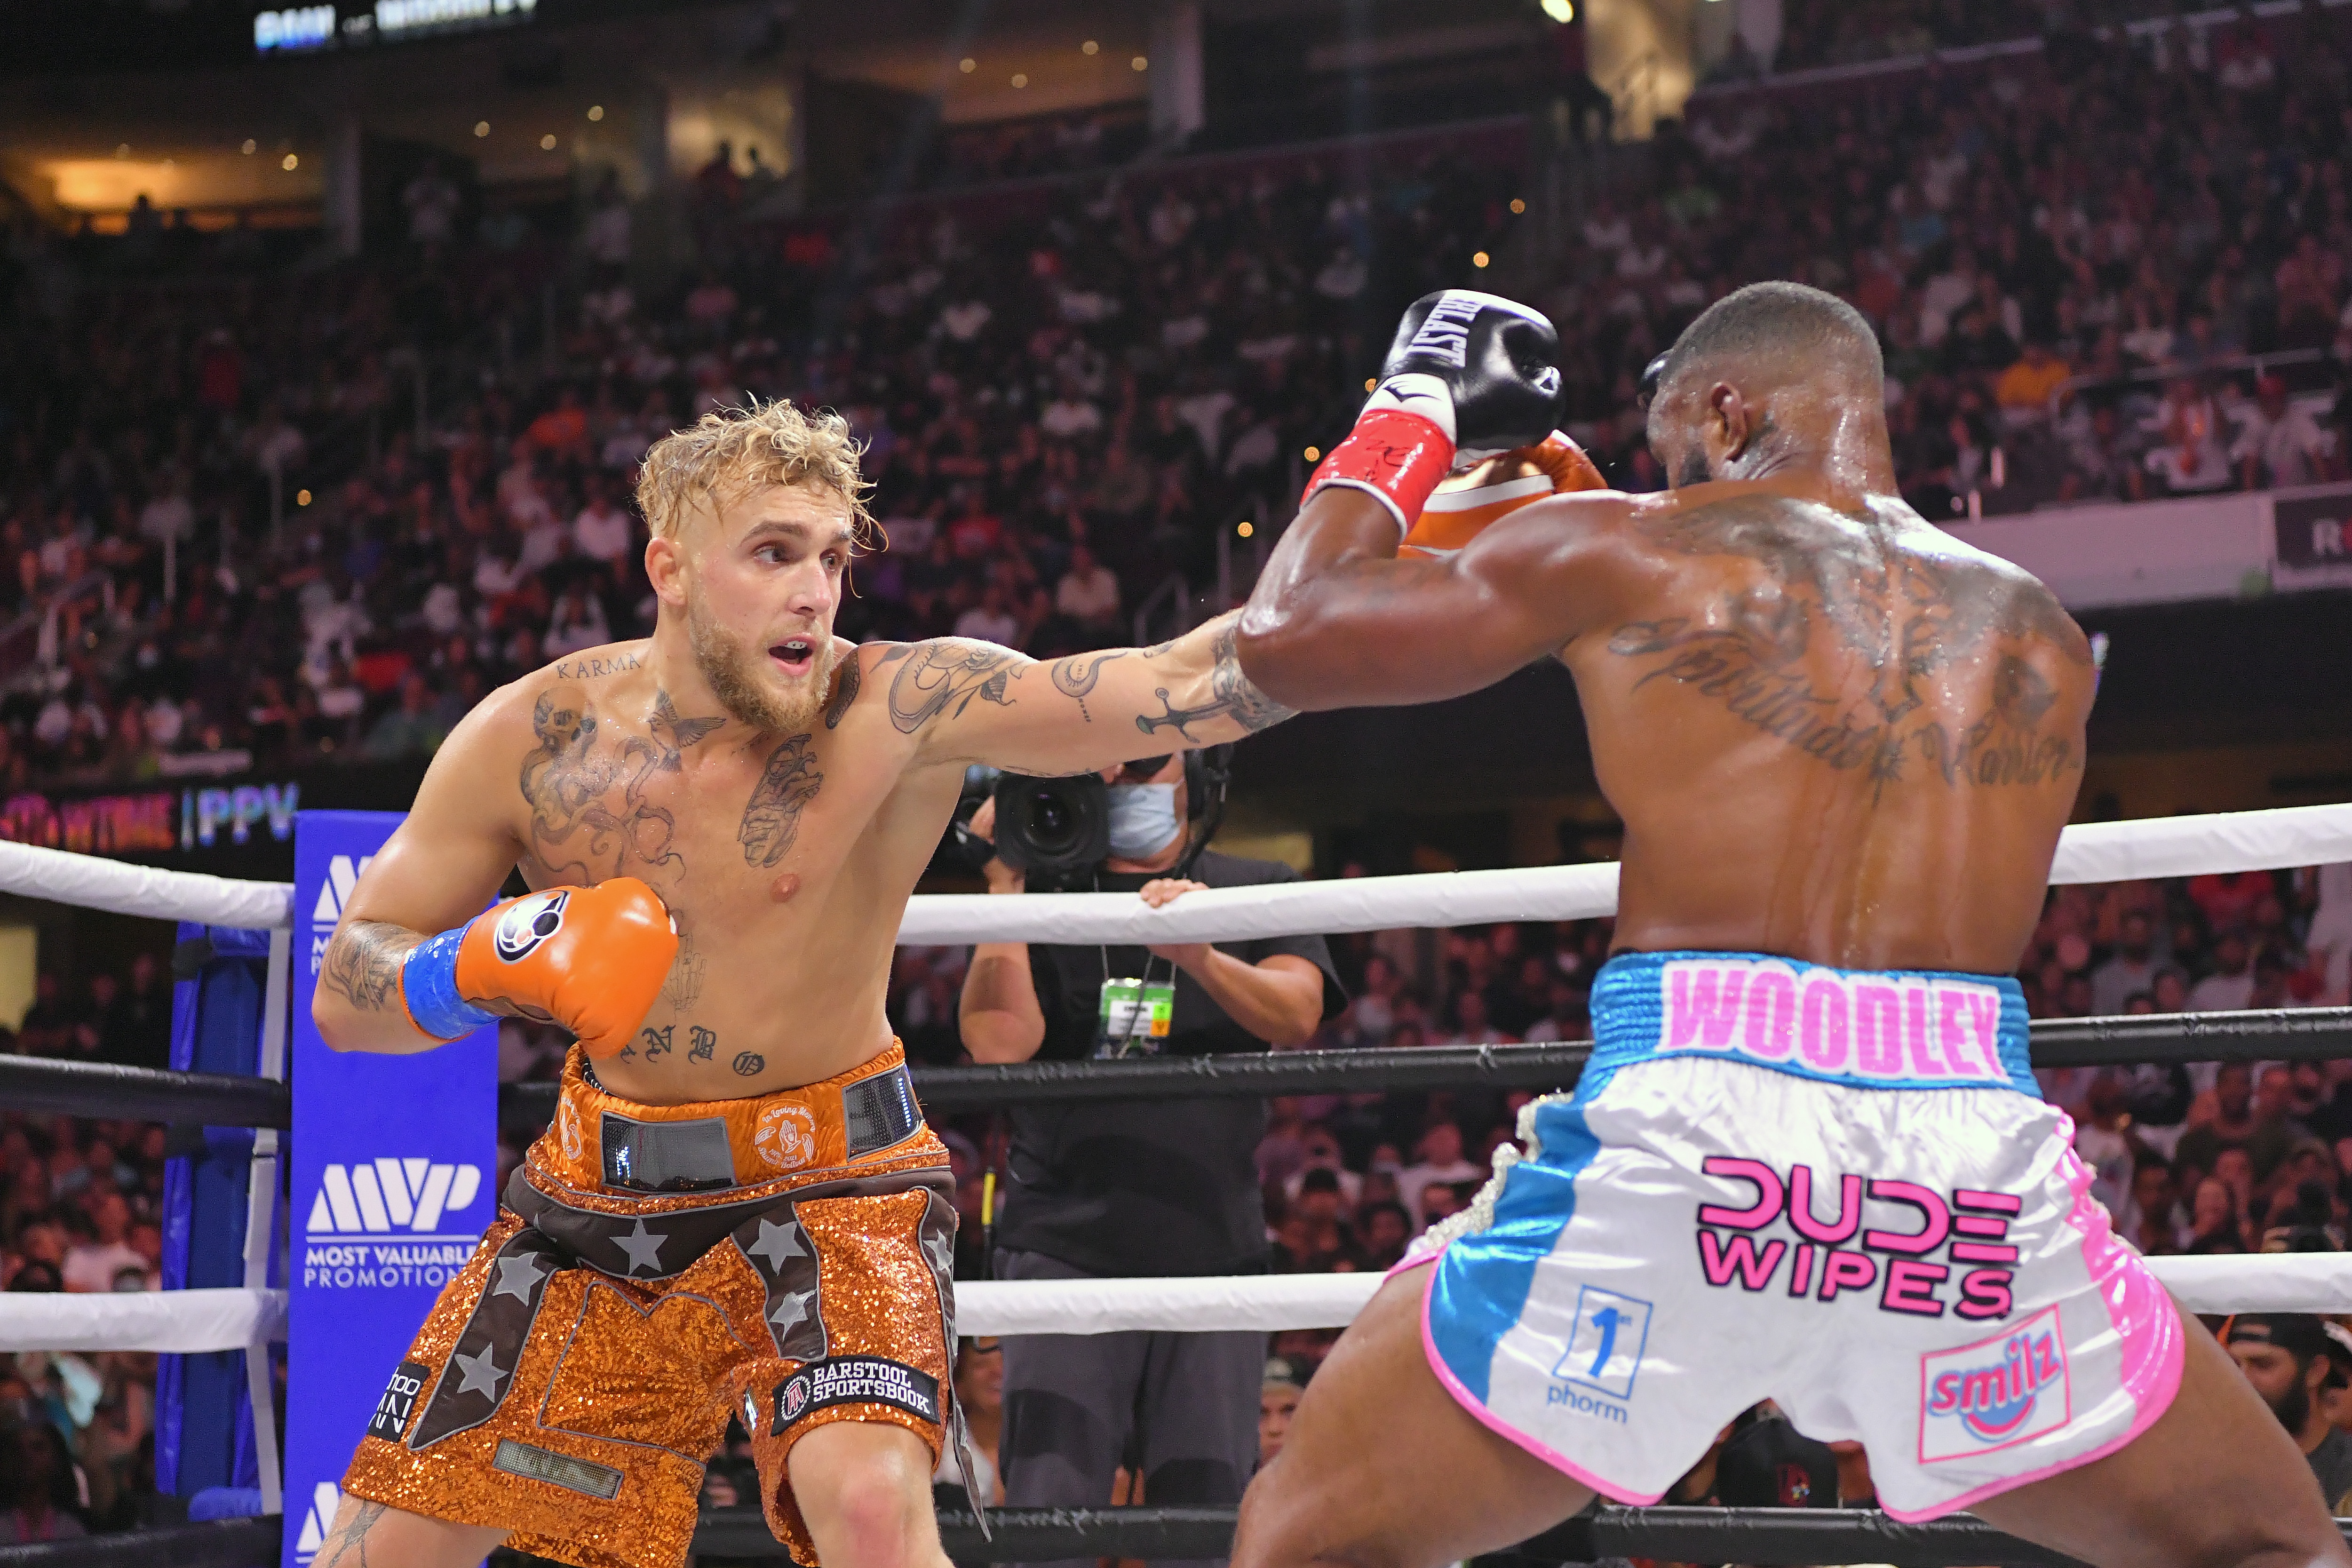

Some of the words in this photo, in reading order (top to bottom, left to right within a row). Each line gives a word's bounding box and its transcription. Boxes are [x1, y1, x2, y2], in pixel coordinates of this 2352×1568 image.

[2312, 519, 2352, 556] R
[557, 654, 642, 678] KARMA
[1657, 961, 2011, 1083] WOODLEY
[762, 1114, 773, 1123] In
[771, 1106, 798, 1118] Loving
[798, 1106, 816, 1133] Memory
[306, 1157, 482, 1233] MVP
[1697, 1155, 2022, 1266] DUDE
[305, 1246, 370, 1267] MOST
[1696, 1228, 2014, 1320] WIPES
[812, 1361, 912, 1389] BARSTOOL
[1929, 1332, 2063, 1413] smilz
[812, 1378, 930, 1415] SPORTSBOOK
[1546, 1383, 1629, 1425] phorm
